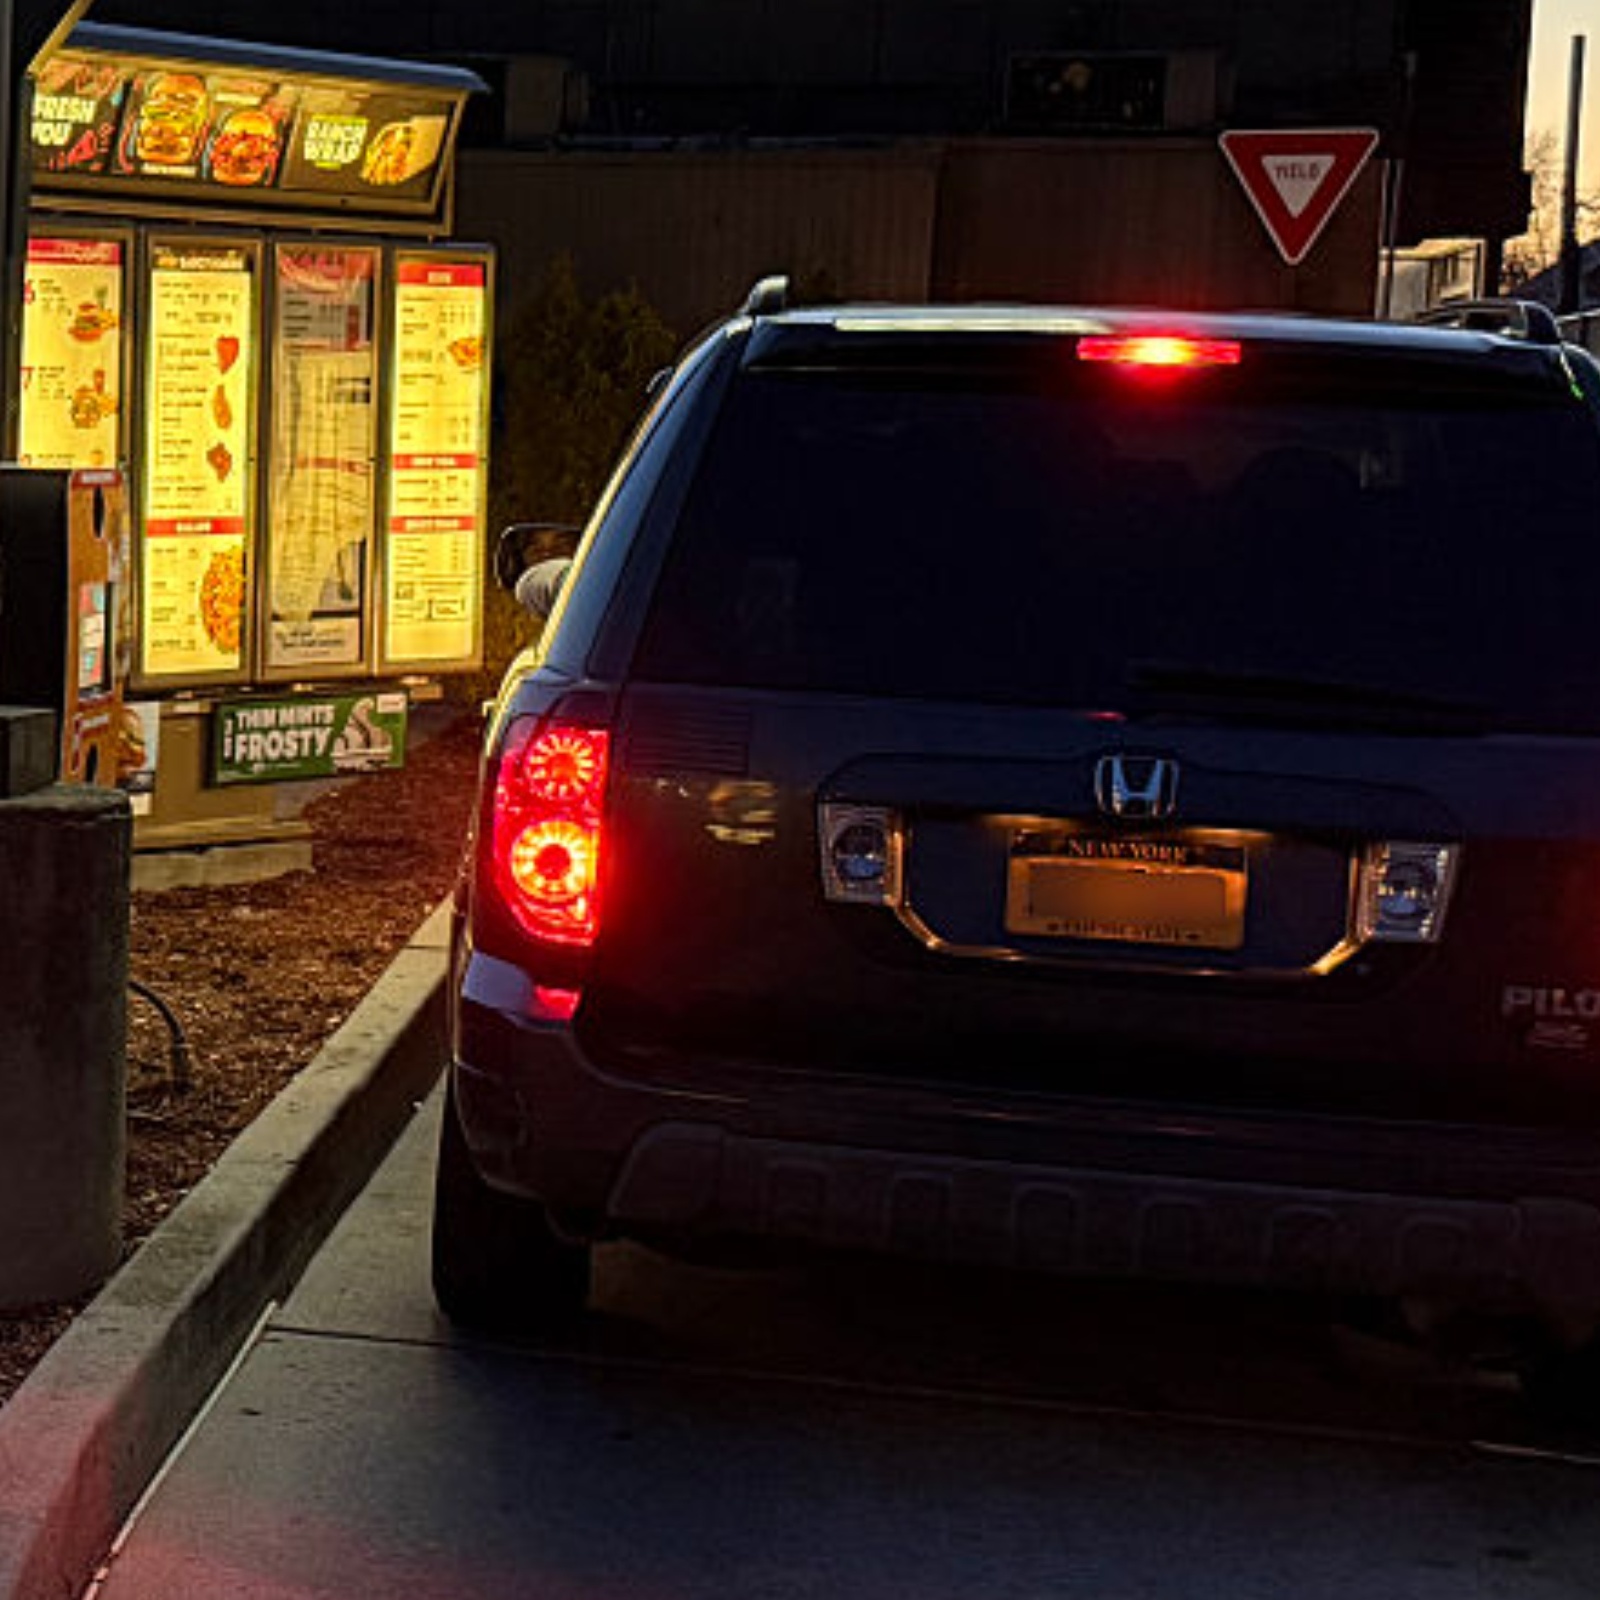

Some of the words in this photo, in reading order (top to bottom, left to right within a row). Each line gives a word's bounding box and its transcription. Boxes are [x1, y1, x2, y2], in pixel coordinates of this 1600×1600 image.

[1274, 162, 1321, 180] YIELD
[236, 707, 276, 731] THIN
[235, 726, 334, 765] FROSTY
[1068, 839, 1123, 858] NEW
